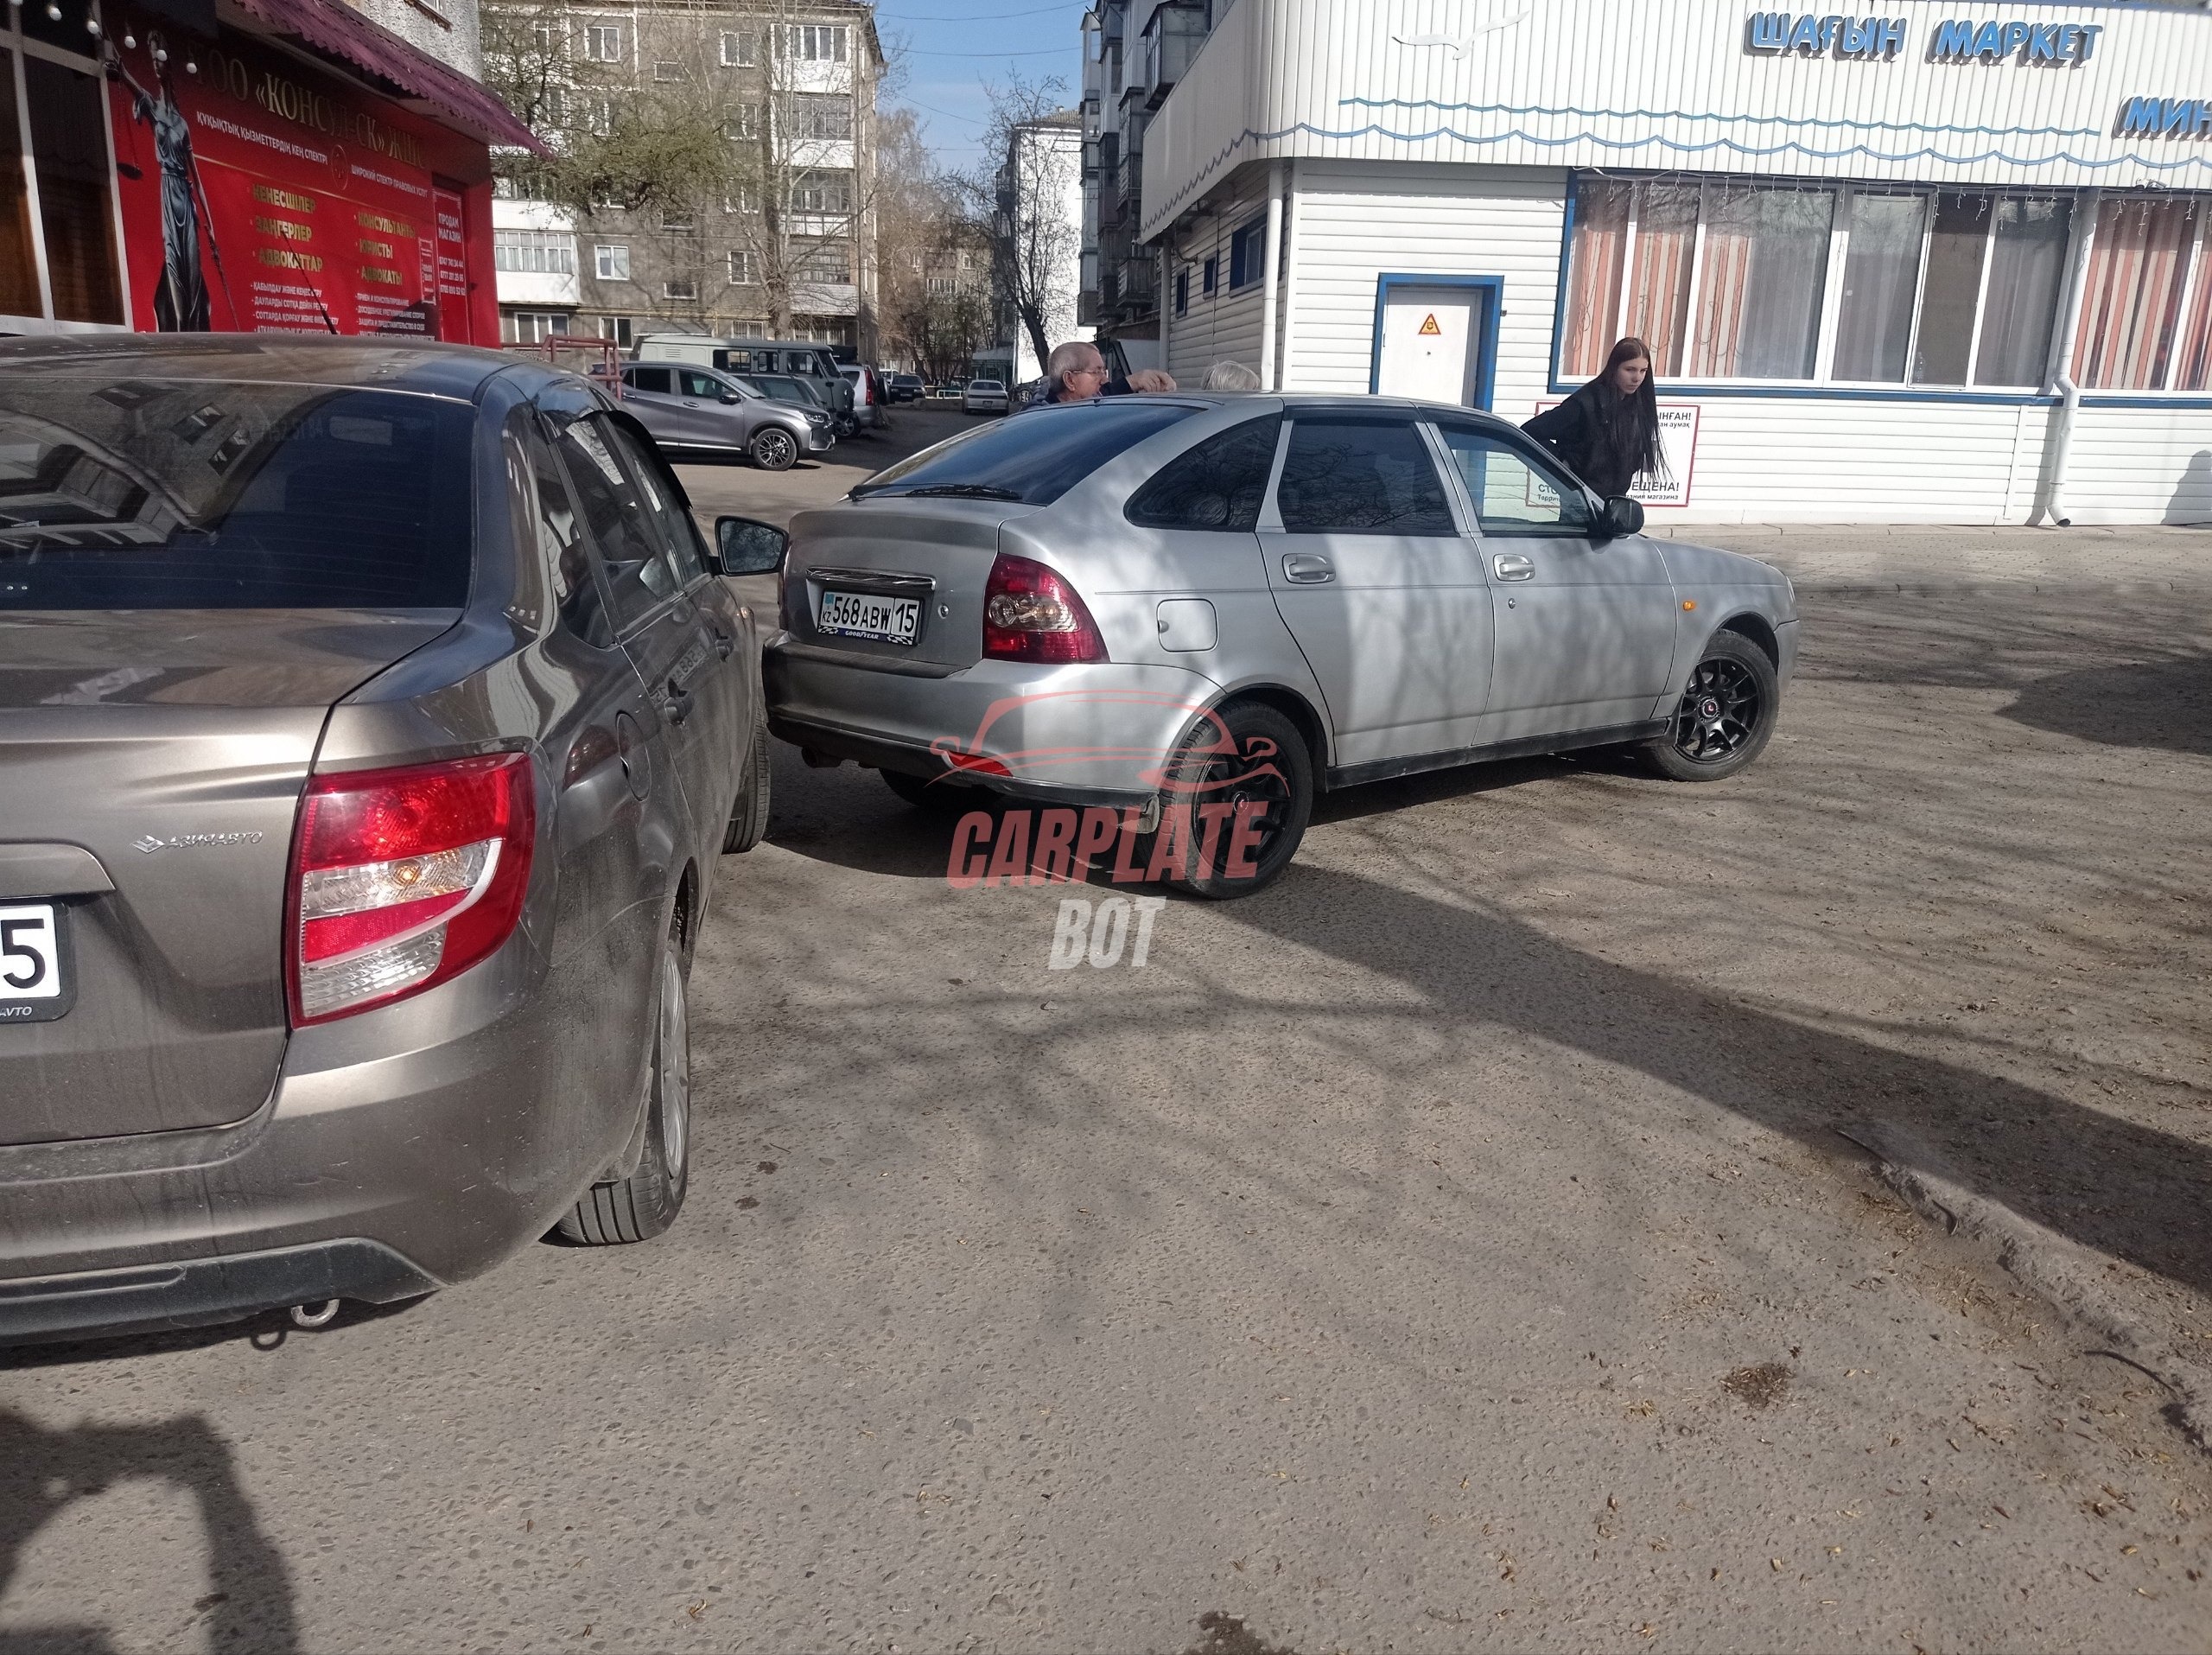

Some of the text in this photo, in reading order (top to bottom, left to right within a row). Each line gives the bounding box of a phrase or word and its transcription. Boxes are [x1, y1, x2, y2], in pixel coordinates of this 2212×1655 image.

[1747, 11, 2102, 66] ШАҒЫН МАРКЕТ
[2115, 95, 2212, 138] МИН
[304, 149, 328, 166] СПЕКТРІ
[376, 174, 393, 187] СПЕКТР
[358, 211, 416, 239] КОНСУЛЬТАНТЫ
[438, 213, 460, 229] ПРОДАМ
[438, 227, 461, 243] МАГАЗИН
[359, 238, 393, 259] ЮРИСТЫ
[259, 247, 323, 273] АДВОКАТТАР
[361, 265, 403, 286] АДВОКАТЫ
[822, 611, 831, 623] KZ
[833, 596, 918, 633] 568ABW 15
[844, 630, 880, 640] GOODYEAR
[0, 918, 46, 990] 5
